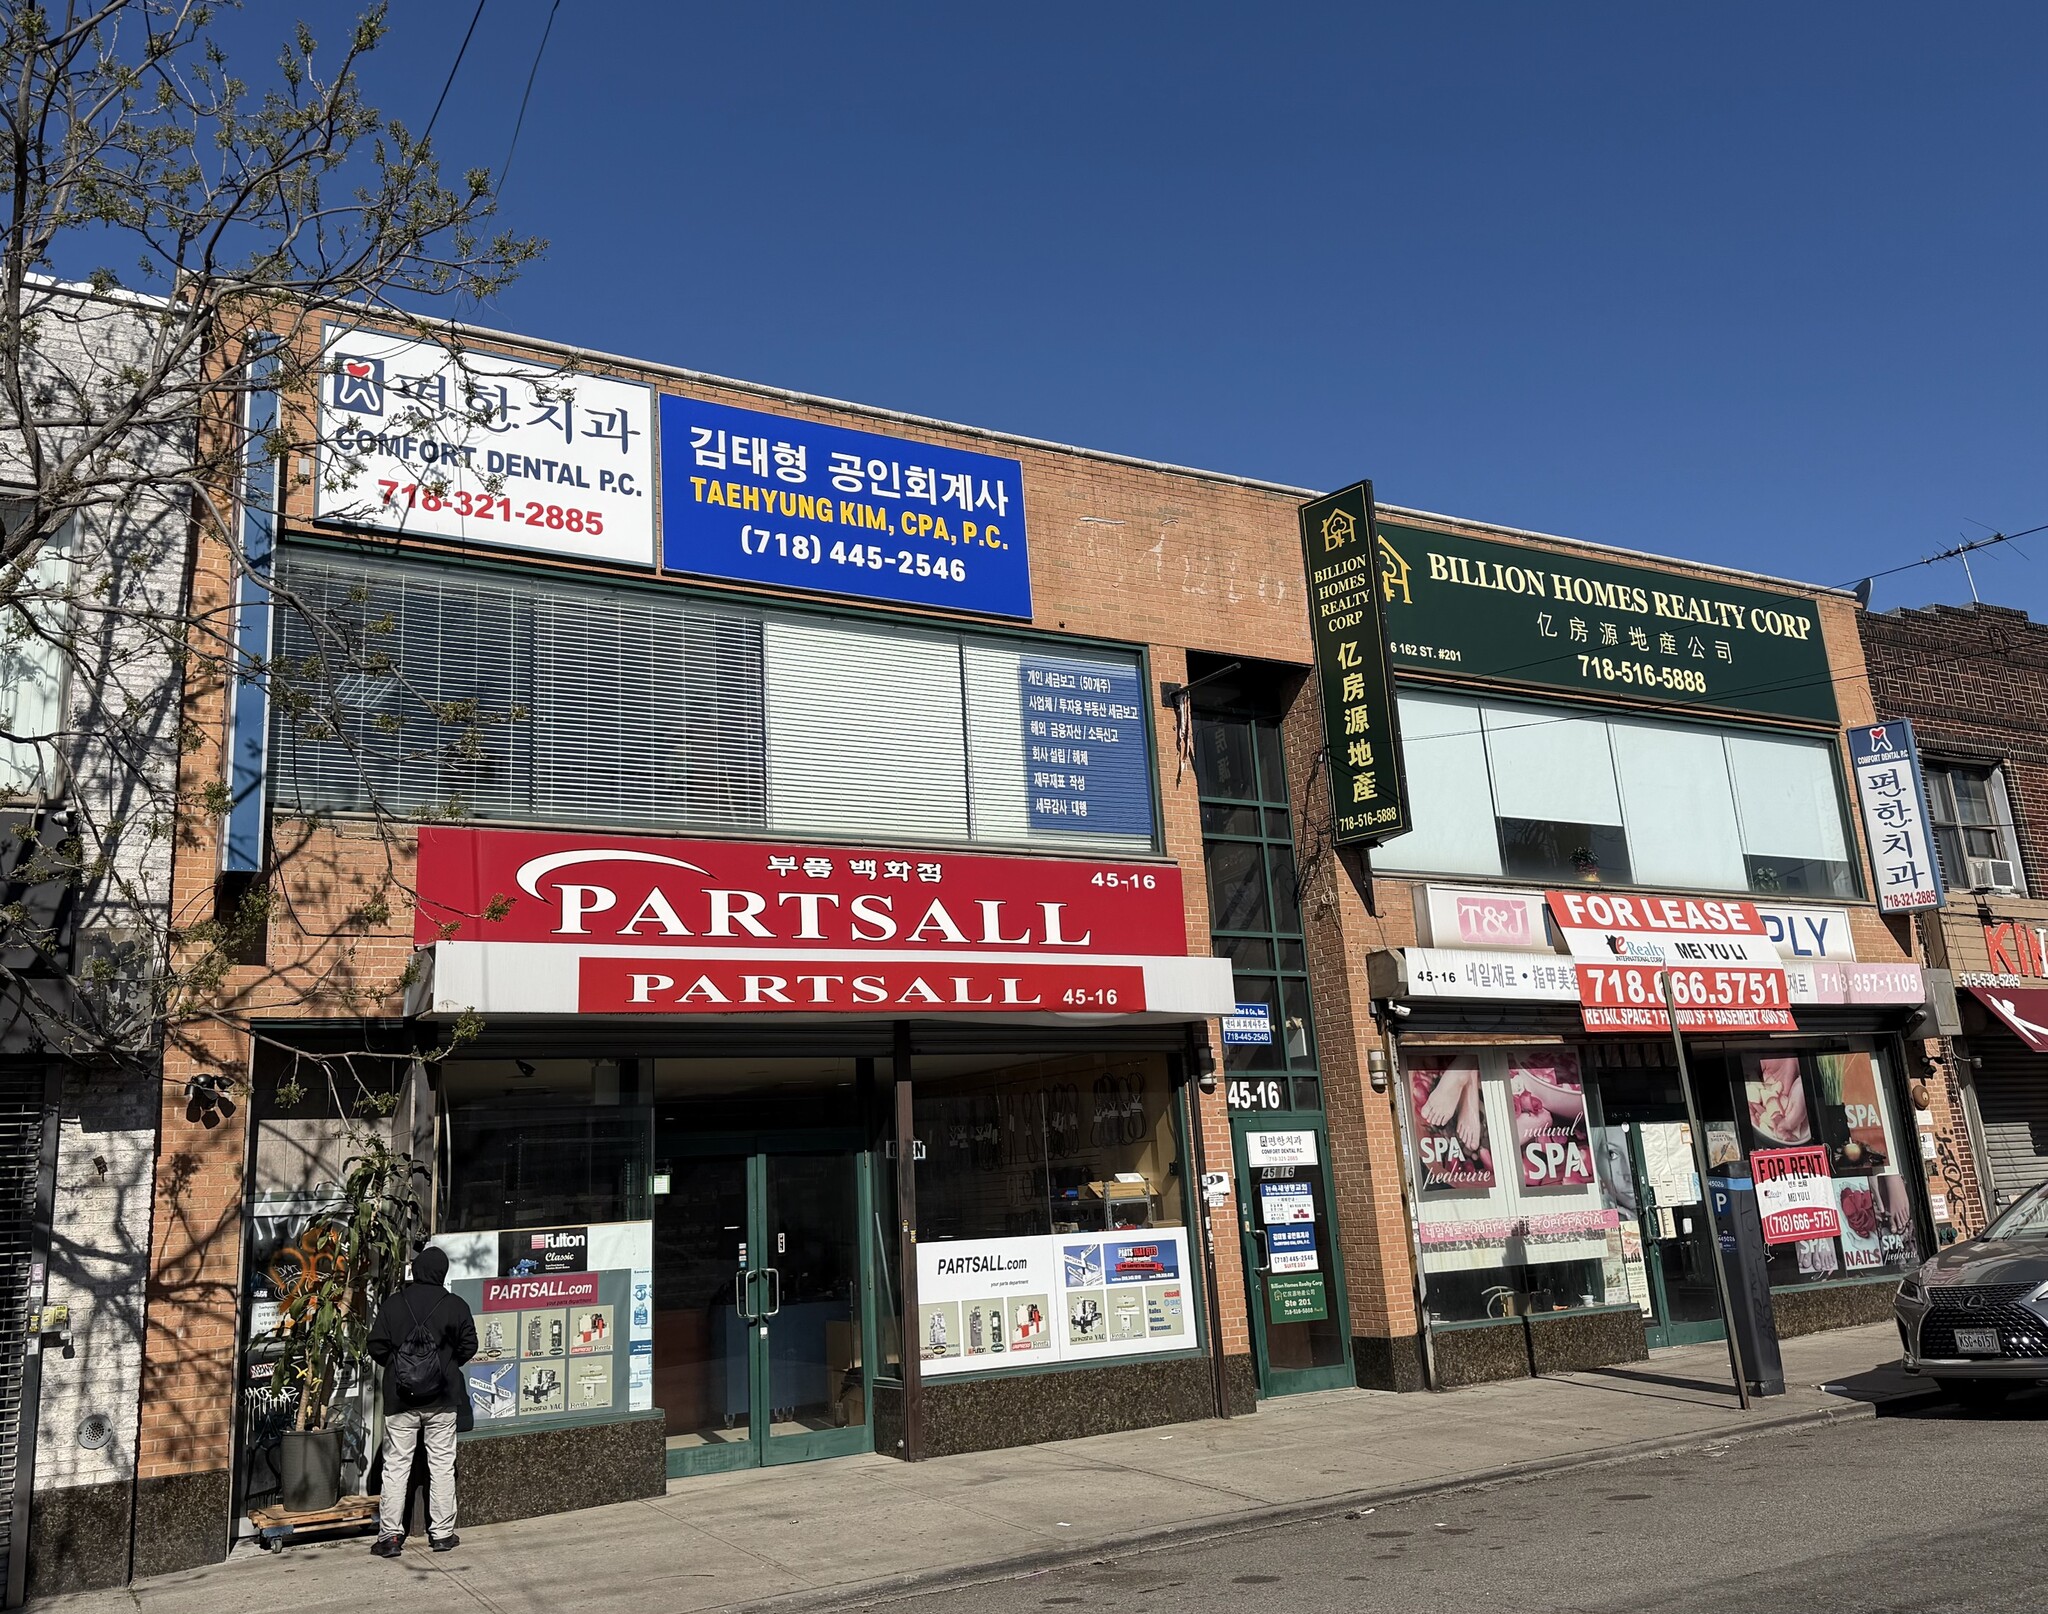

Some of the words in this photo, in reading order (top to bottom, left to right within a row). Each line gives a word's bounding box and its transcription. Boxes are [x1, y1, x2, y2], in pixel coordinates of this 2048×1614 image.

[393, 374, 640, 454] 편한치과
[336, 427, 477, 468] COMFORT
[488, 450, 590, 488] DENTAL
[600, 470, 642, 496] P.C.
[690, 426, 807, 483] 김태형
[829, 452, 1008, 517] 공인회계사
[378, 479, 604, 535] 718-321-2885
[690, 476, 833, 522] TAEHYUNG
[840, 502, 894, 536] KIM,
[902, 512, 957, 546] CPA,
[963, 520, 1008, 550] P.C.
[741, 525, 821, 564] (718)
[830, 541, 966, 583] 445-2546
[1314, 554, 1367, 584] BILLION
[1318, 573, 1366, 600] HOMES
[1427, 552, 1546, 597] BILLION
[1550, 573, 1649, 615] HOMES
[1652, 590, 1746, 630] REALTY
[1751, 608, 1811, 640] CORP
[1320, 589, 1371, 618] REALTY
[1328, 610, 1363, 633] CORP
[1399, 642, 1418, 656] 162
[1420, 646, 1437, 659] ST.
[1438, 648, 1462, 662] #201
[1028, 670, 1043, 686] 개인
[1045, 673, 1076, 689] 세금보고
[1080, 676, 1111, 693] (50개주)
[1577, 654, 1707, 694] 718-516-5888
[1029, 695, 1053, 712] 사업체
[1059, 699, 1083, 716] 투자용
[1084, 701, 1107, 717] 부동산
[1109, 705, 1139, 719] 세금보고
[1030, 720, 1047, 736] 해외
[1051, 722, 1082, 739] 금융자산
[1088, 727, 1119, 743] 소득신고
[1337, 641, 1378, 804] 亿房源地產
[1032, 746, 1048, 762] 회사
[1050, 748, 1066, 763] 설립
[1857, 754, 1881, 765] COMFORT
[1881, 751, 1900, 762] DENTAL
[1070, 775, 1085, 791] 작성
[1035, 798, 1067, 815] 세무감사
[1072, 801, 1087, 817] 대행
[1339, 806, 1397, 832] 718-516-5888
[1867, 768, 1925, 889] 편한치과
[766, 855, 834, 880] 부품
[849, 858, 942, 884] 백화점
[1091, 872, 1156, 892] 45-16
[1883, 890, 1936, 909] 718-321-2885
[550, 883, 1092, 947] PARTSALL
[1460, 904, 1523, 936] T&J
[1563, 894, 1641, 927] FOR
[1640, 898, 1751, 931] LEASE
[1674, 942, 1707, 960] MEI
[1704, 943, 1730, 960] YU
[1729, 944, 1748, 960] LI
[1465, 962, 1518, 988] 네일재료
[1960, 972, 2021, 988] 315-538-5285
[625, 973, 1042, 1005] PARTSALL
[1062, 988, 1118, 1006] 45-16
[1585, 1009, 1621, 1025] RETAIL
[1621, 1009, 1651, 1025] SPACE
[1652, 1009, 1660, 1025] 1
[1696, 1009, 1707, 1025] SF
[1715, 1009, 1761, 1025] BASEMENT
[1762, 1009, 1779, 1024] 800
[1779, 1010, 1790, 1024] SF
[1226, 1032, 1269, 1041] 718-445-2546
[1228, 1080, 1280, 1109] 45-16
[1523, 1111, 1583, 1138] natural
[1844, 1104, 1881, 1128] SPA
[1420, 1136, 1466, 1164] SPA
[1525, 1141, 1589, 1180] SPA
[1422, 1161, 1491, 1191] pedicure
[1757, 1158, 1788, 1183] FOR
[1790, 1154, 1823, 1181] RENT
[1715, 1193, 1727, 1212] P
[1568, 1215, 1607, 1227] FACIAL
[1769, 1210, 1834, 1235] (718)666-5751
[545, 1233, 586, 1249] Fulton
[1882, 1234, 1904, 1250] SPA
[545, 1251, 575, 1262] Classic
[937, 1254, 1028, 1275] PARTSALL.com
[1845, 1249, 1881, 1267] NAILS
[489, 1281, 592, 1301] PARTSALL.com
[1298, 1298, 1311, 1306] 201
[550, 1403, 563, 1411] YAC
